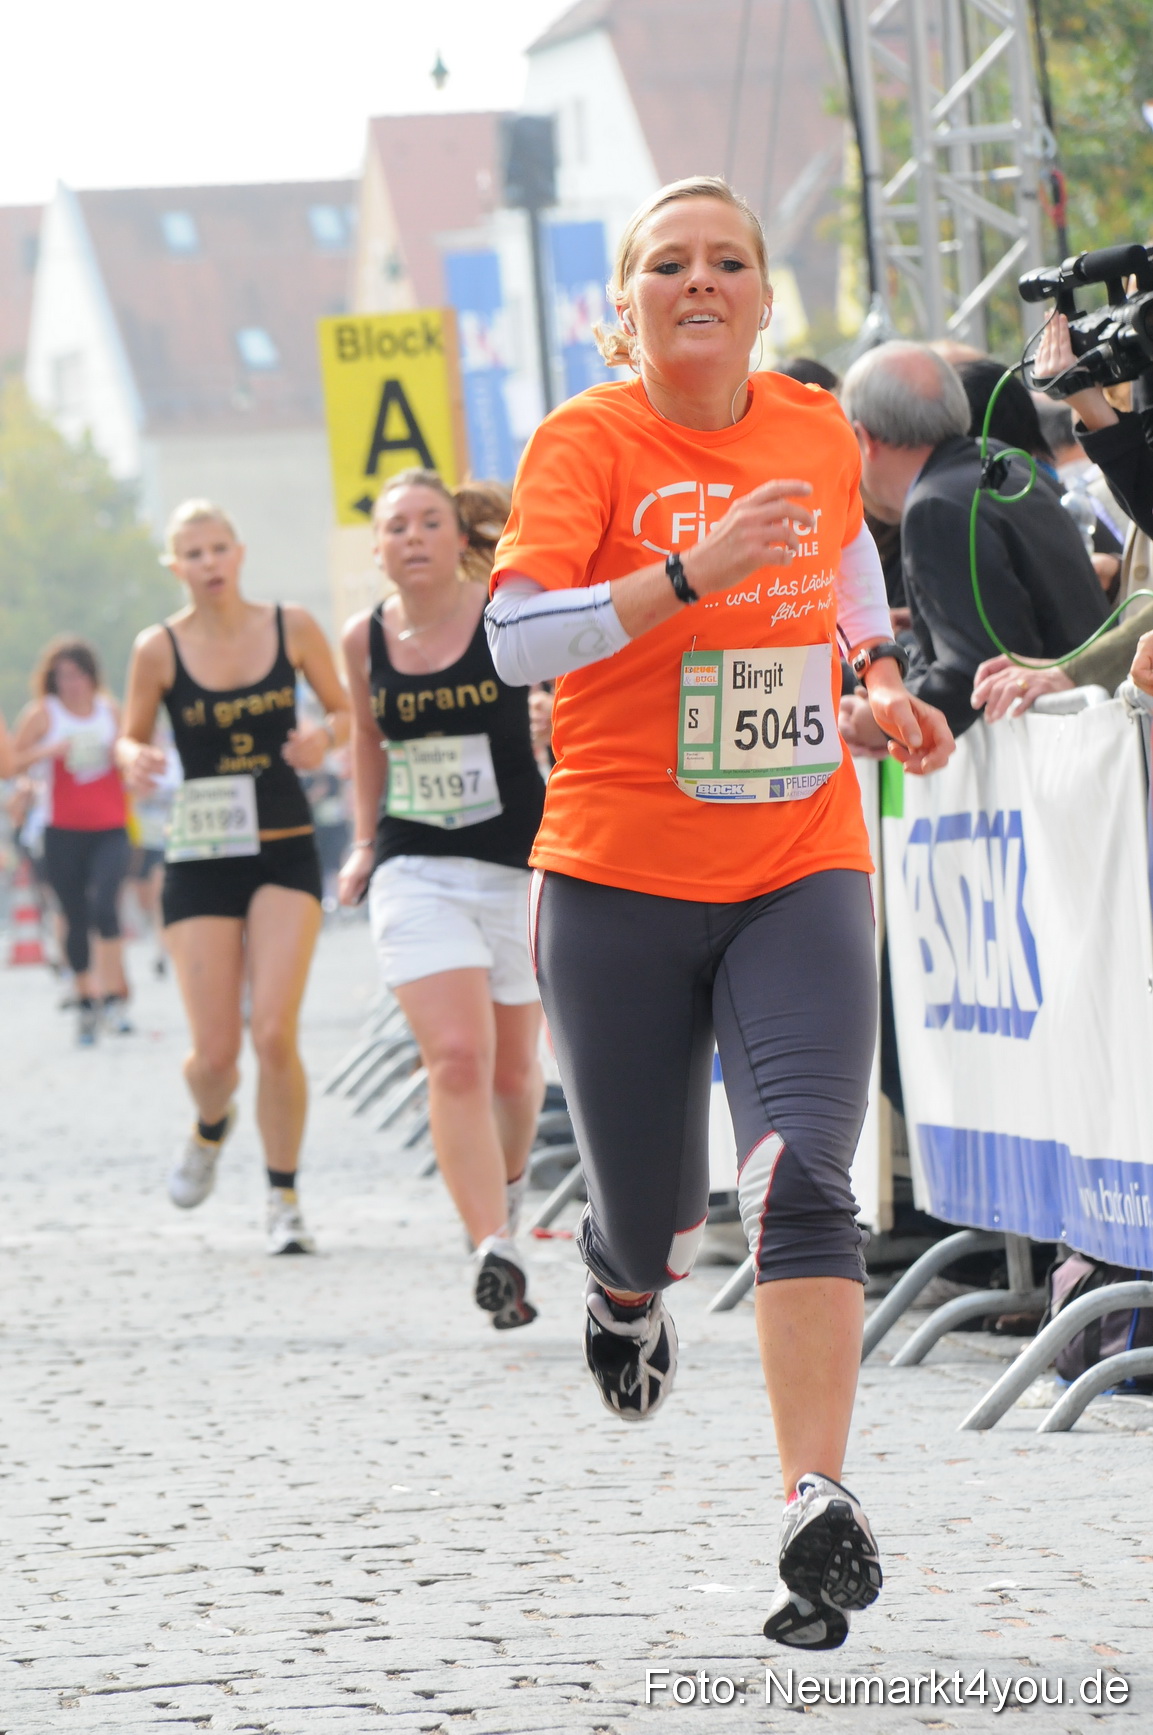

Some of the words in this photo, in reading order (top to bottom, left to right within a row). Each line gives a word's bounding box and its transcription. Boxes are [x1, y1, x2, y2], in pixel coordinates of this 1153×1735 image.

[335, 319, 443, 363] Block
[366, 379, 436, 476] A
[726, 583, 760, 606] und
[767, 577, 798, 597] das
[770, 600, 815, 628] fährt
[733, 661, 784, 694] Birgit
[397, 679, 498, 722] grano
[688, 708, 699, 728] S
[734, 705, 825, 751] 5045
[418, 768, 482, 799] 5197
[696, 784, 744, 794] BOCK
[902, 810, 1043, 1040] BOCK
